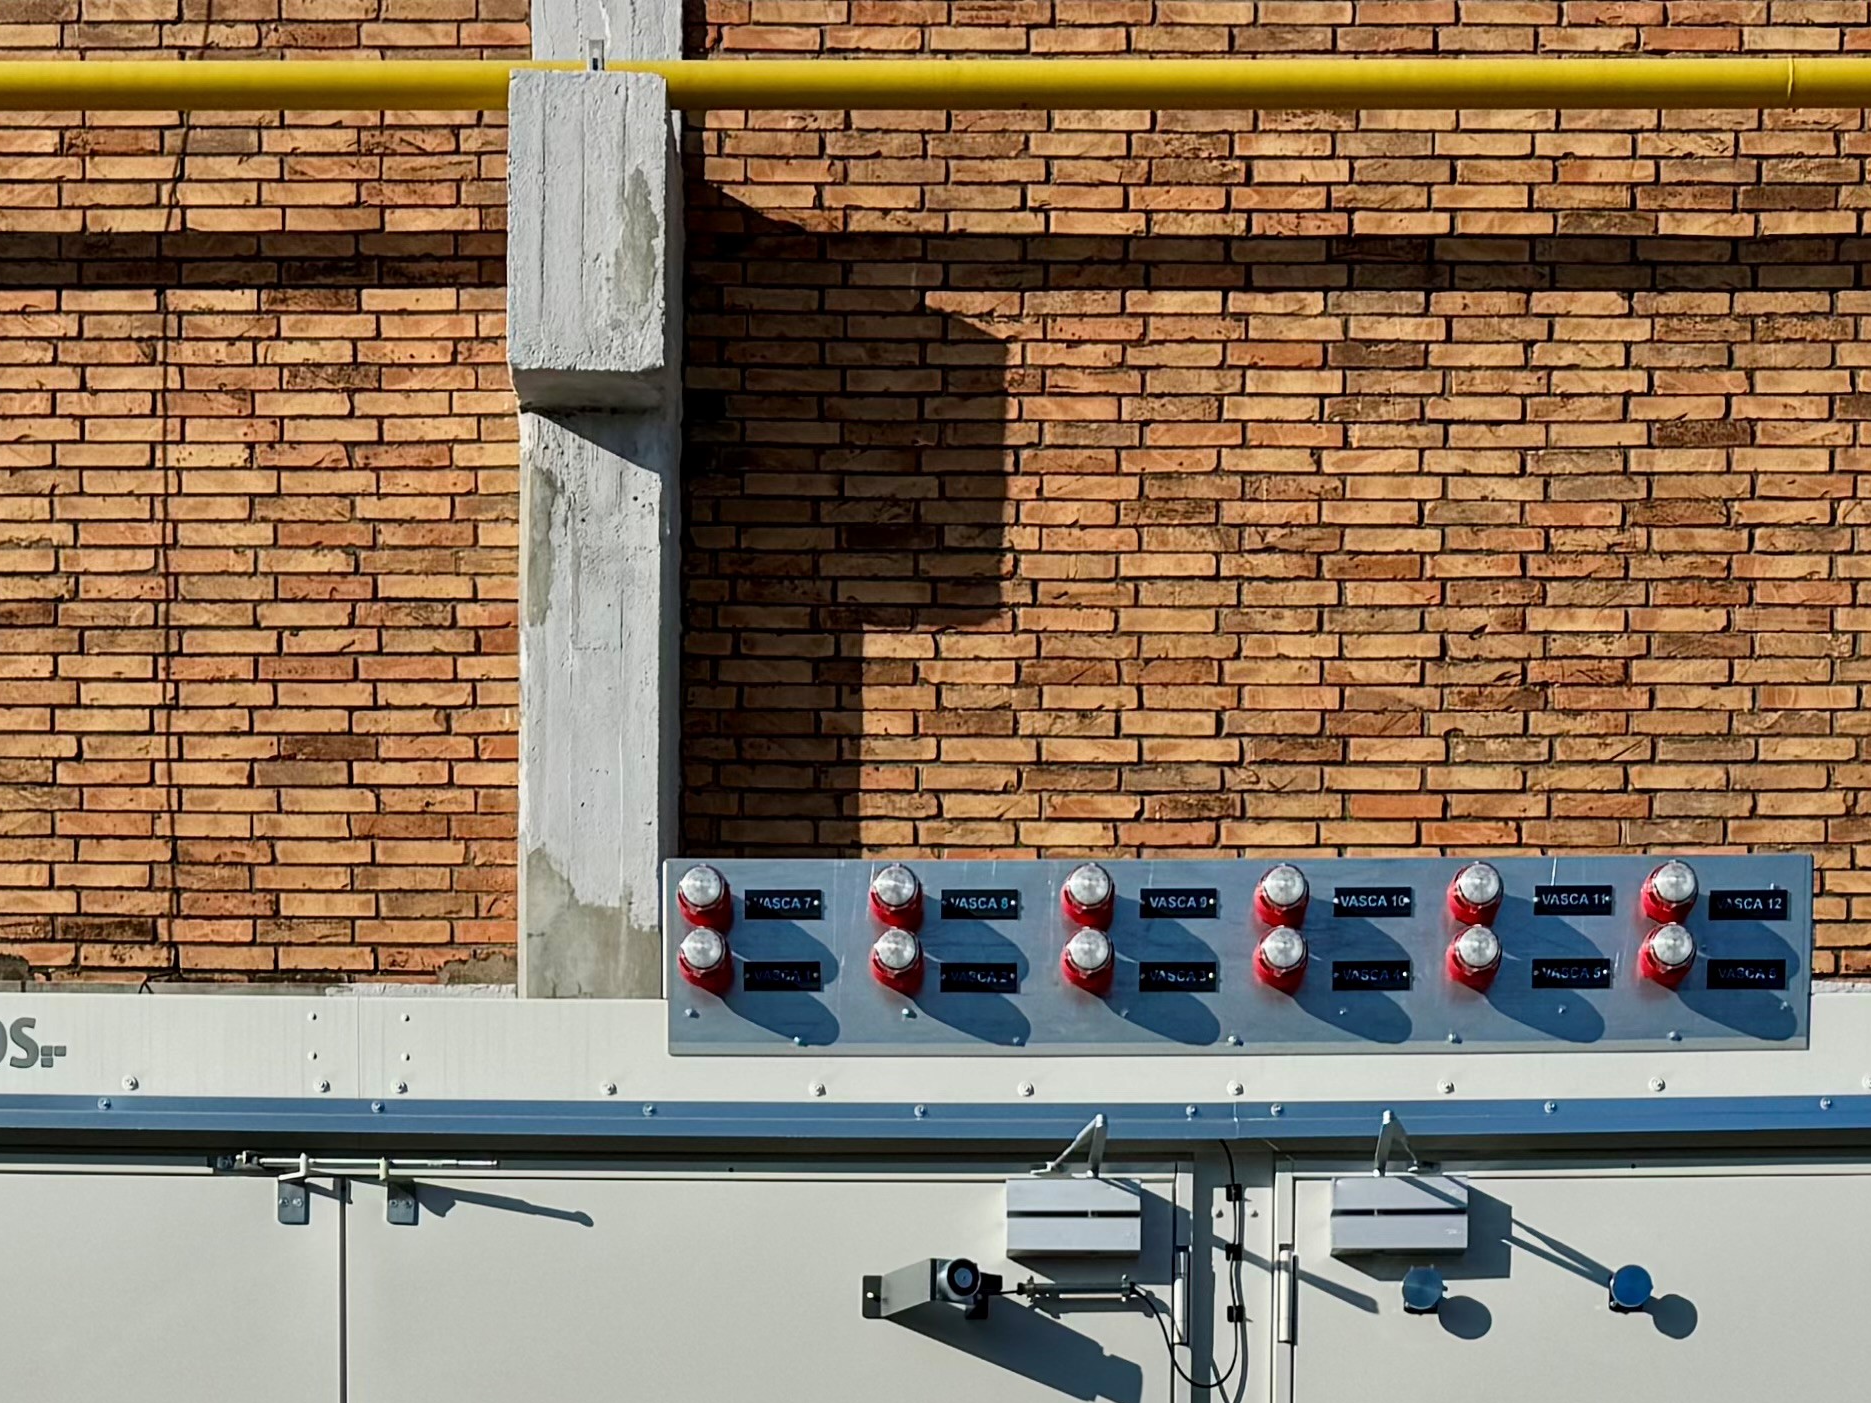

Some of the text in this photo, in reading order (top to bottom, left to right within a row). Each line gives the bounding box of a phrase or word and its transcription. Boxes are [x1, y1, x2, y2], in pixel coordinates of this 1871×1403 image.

[754, 896, 811, 910] VASCA 7
[950, 896, 1009, 910] VASCA 8
[1149, 895, 1208, 909] VASCA 9
[1340, 894, 1406, 908] VASCA 10
[1542, 893, 1606, 906] VASCA 11
[1717, 897, 1782, 910] VASCA 12
[754, 970, 801, 982] VASCA
[950, 971, 998, 983] VASCA
[1149, 969, 1196, 982] VASCA
[1342, 968, 1389, 981] VASCA
[1542, 967, 1590, 979] VASCA
[1717, 967, 1765, 979] VASCA
